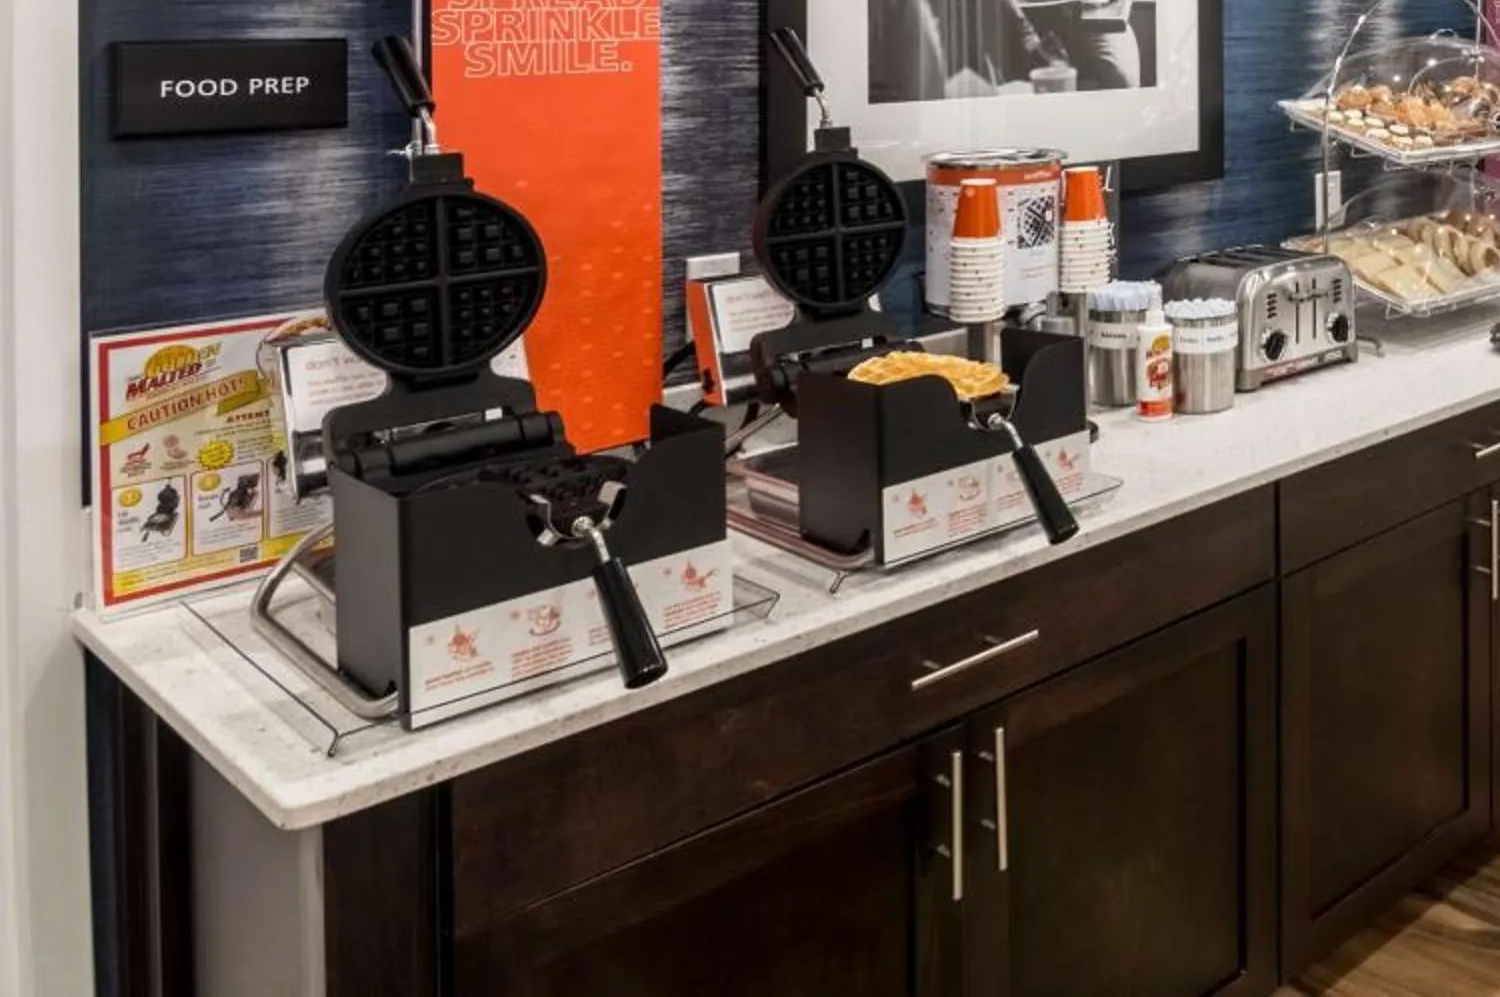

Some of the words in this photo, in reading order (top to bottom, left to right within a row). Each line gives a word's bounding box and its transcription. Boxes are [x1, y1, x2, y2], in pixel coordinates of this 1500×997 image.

[431, 6, 661, 46] SPRINKLE
[464, 40, 633, 78] SMILE.
[160, 79, 238, 98] FOOD
[249, 76, 310, 95] PREP
[127, 394, 200, 430] CAUTION
